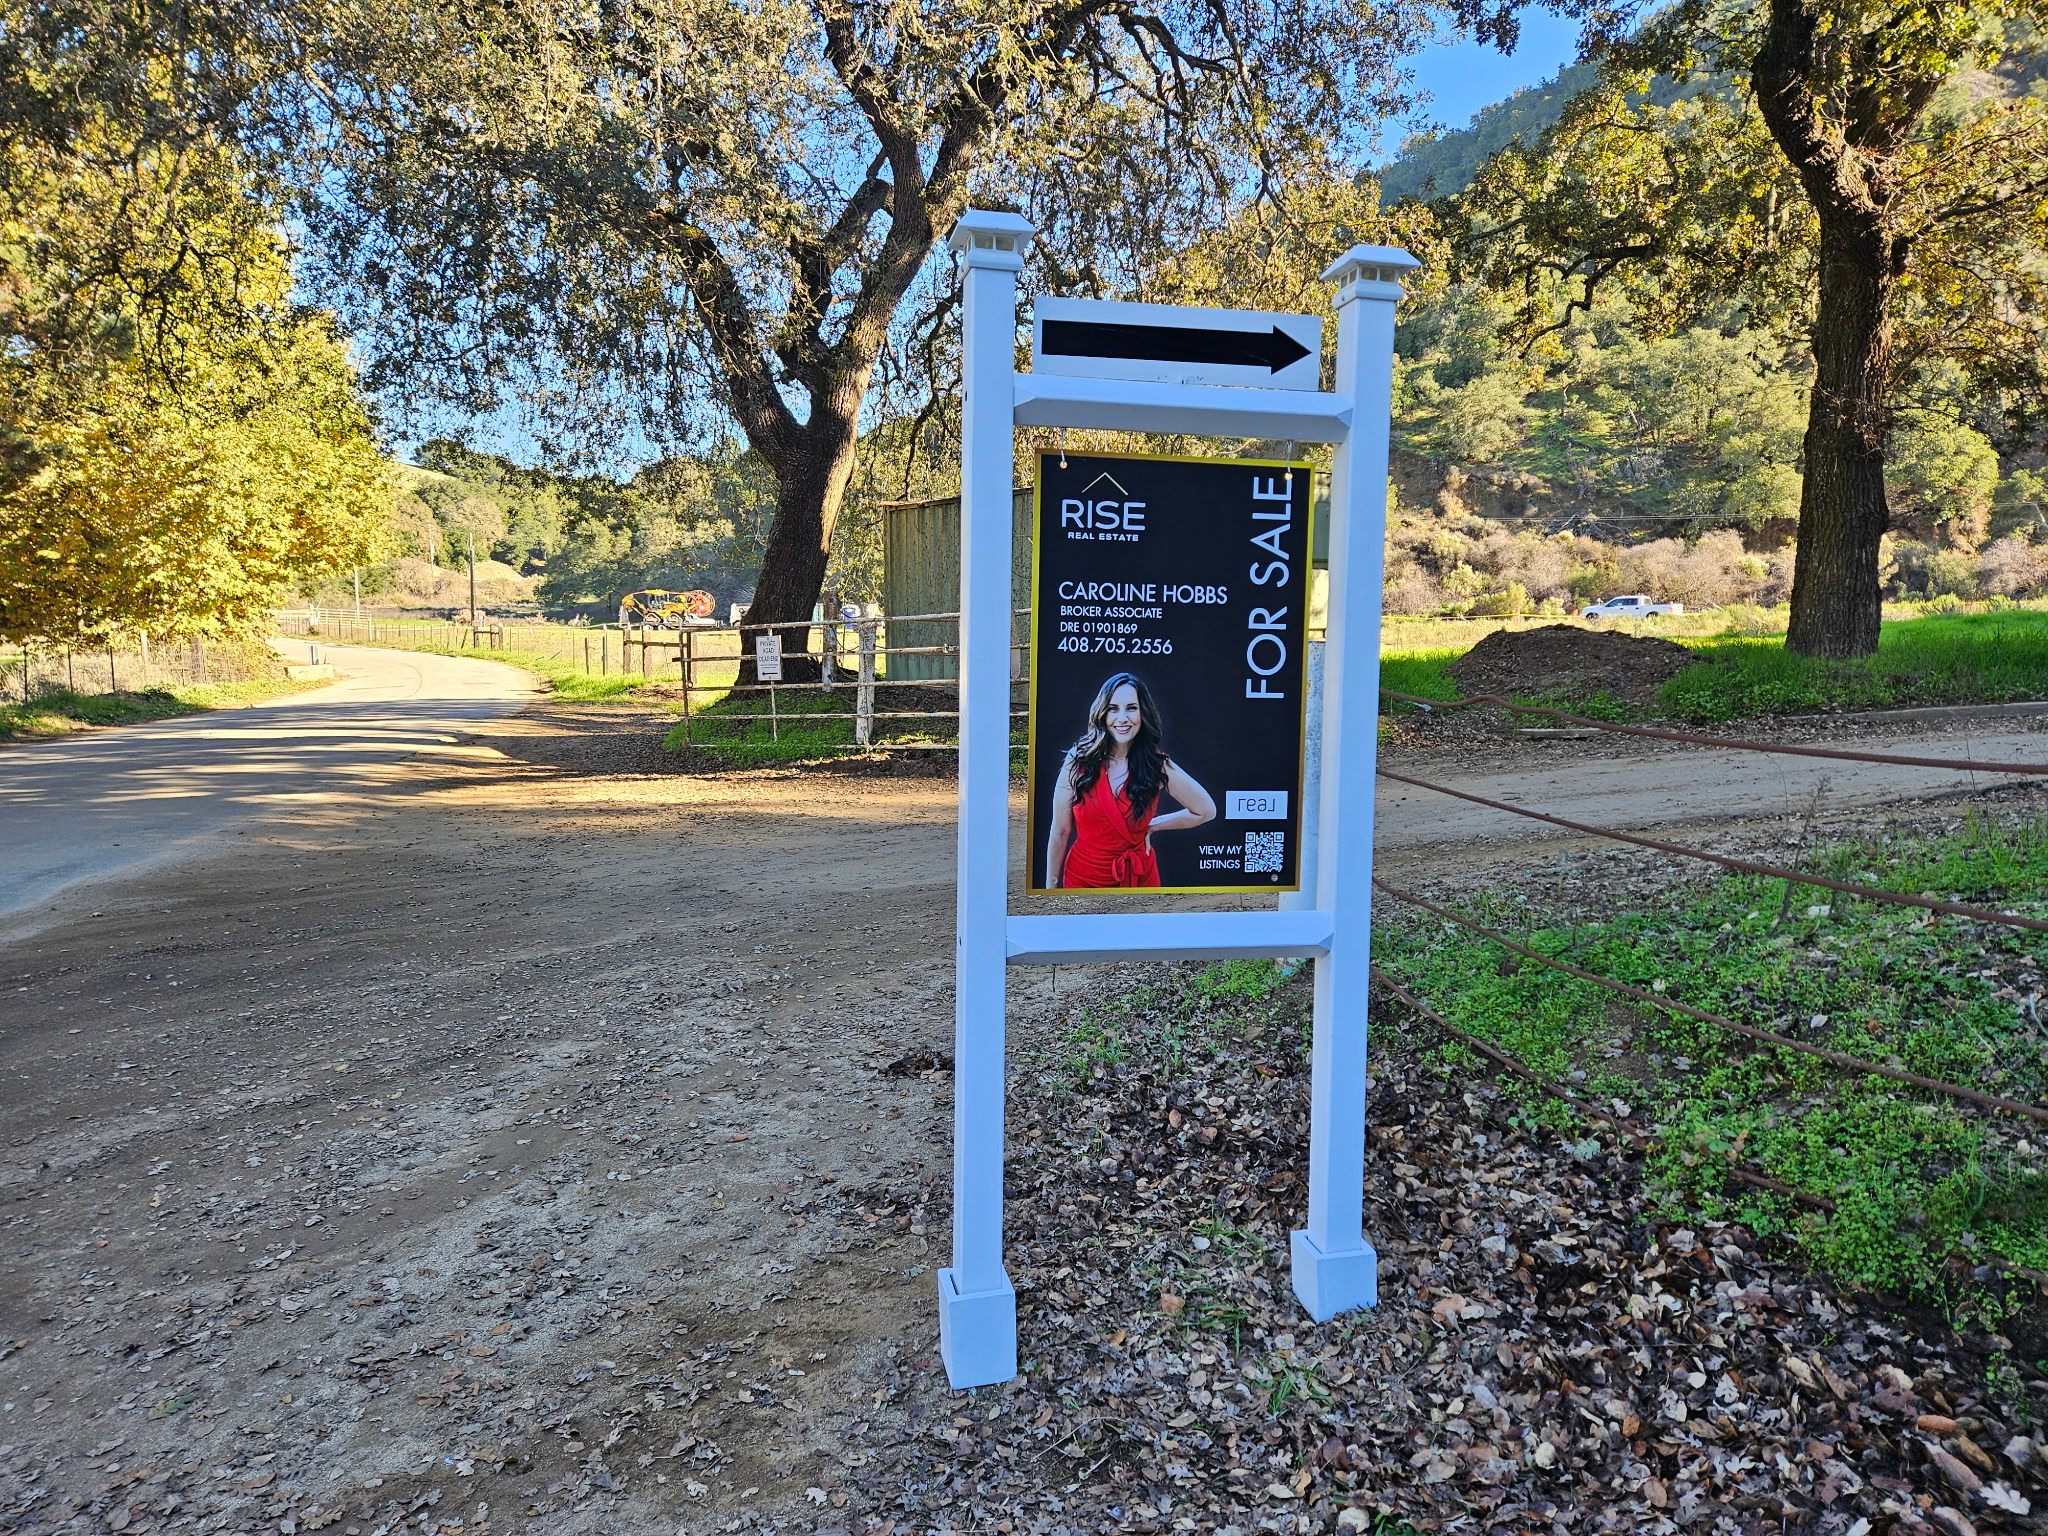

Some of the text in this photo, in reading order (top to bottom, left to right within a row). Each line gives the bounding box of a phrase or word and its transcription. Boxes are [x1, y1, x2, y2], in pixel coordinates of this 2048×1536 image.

[1061, 499, 1146, 531] RISE
[1067, 532, 1139, 542] REAL ESTATE
[1058, 581, 1228, 605] CAROLINE HOBBS
[1245, 476, 1292, 699] FOR SALE
[1060, 606, 1163, 619] BROKER ASSOCIATE
[1060, 622, 1138, 634] DRE 01901869
[1057, 637, 1173, 655] 408.705.2556
[1199, 845, 1242, 855] VIEW MY
[1199, 859, 1241, 870] LISTINGS
